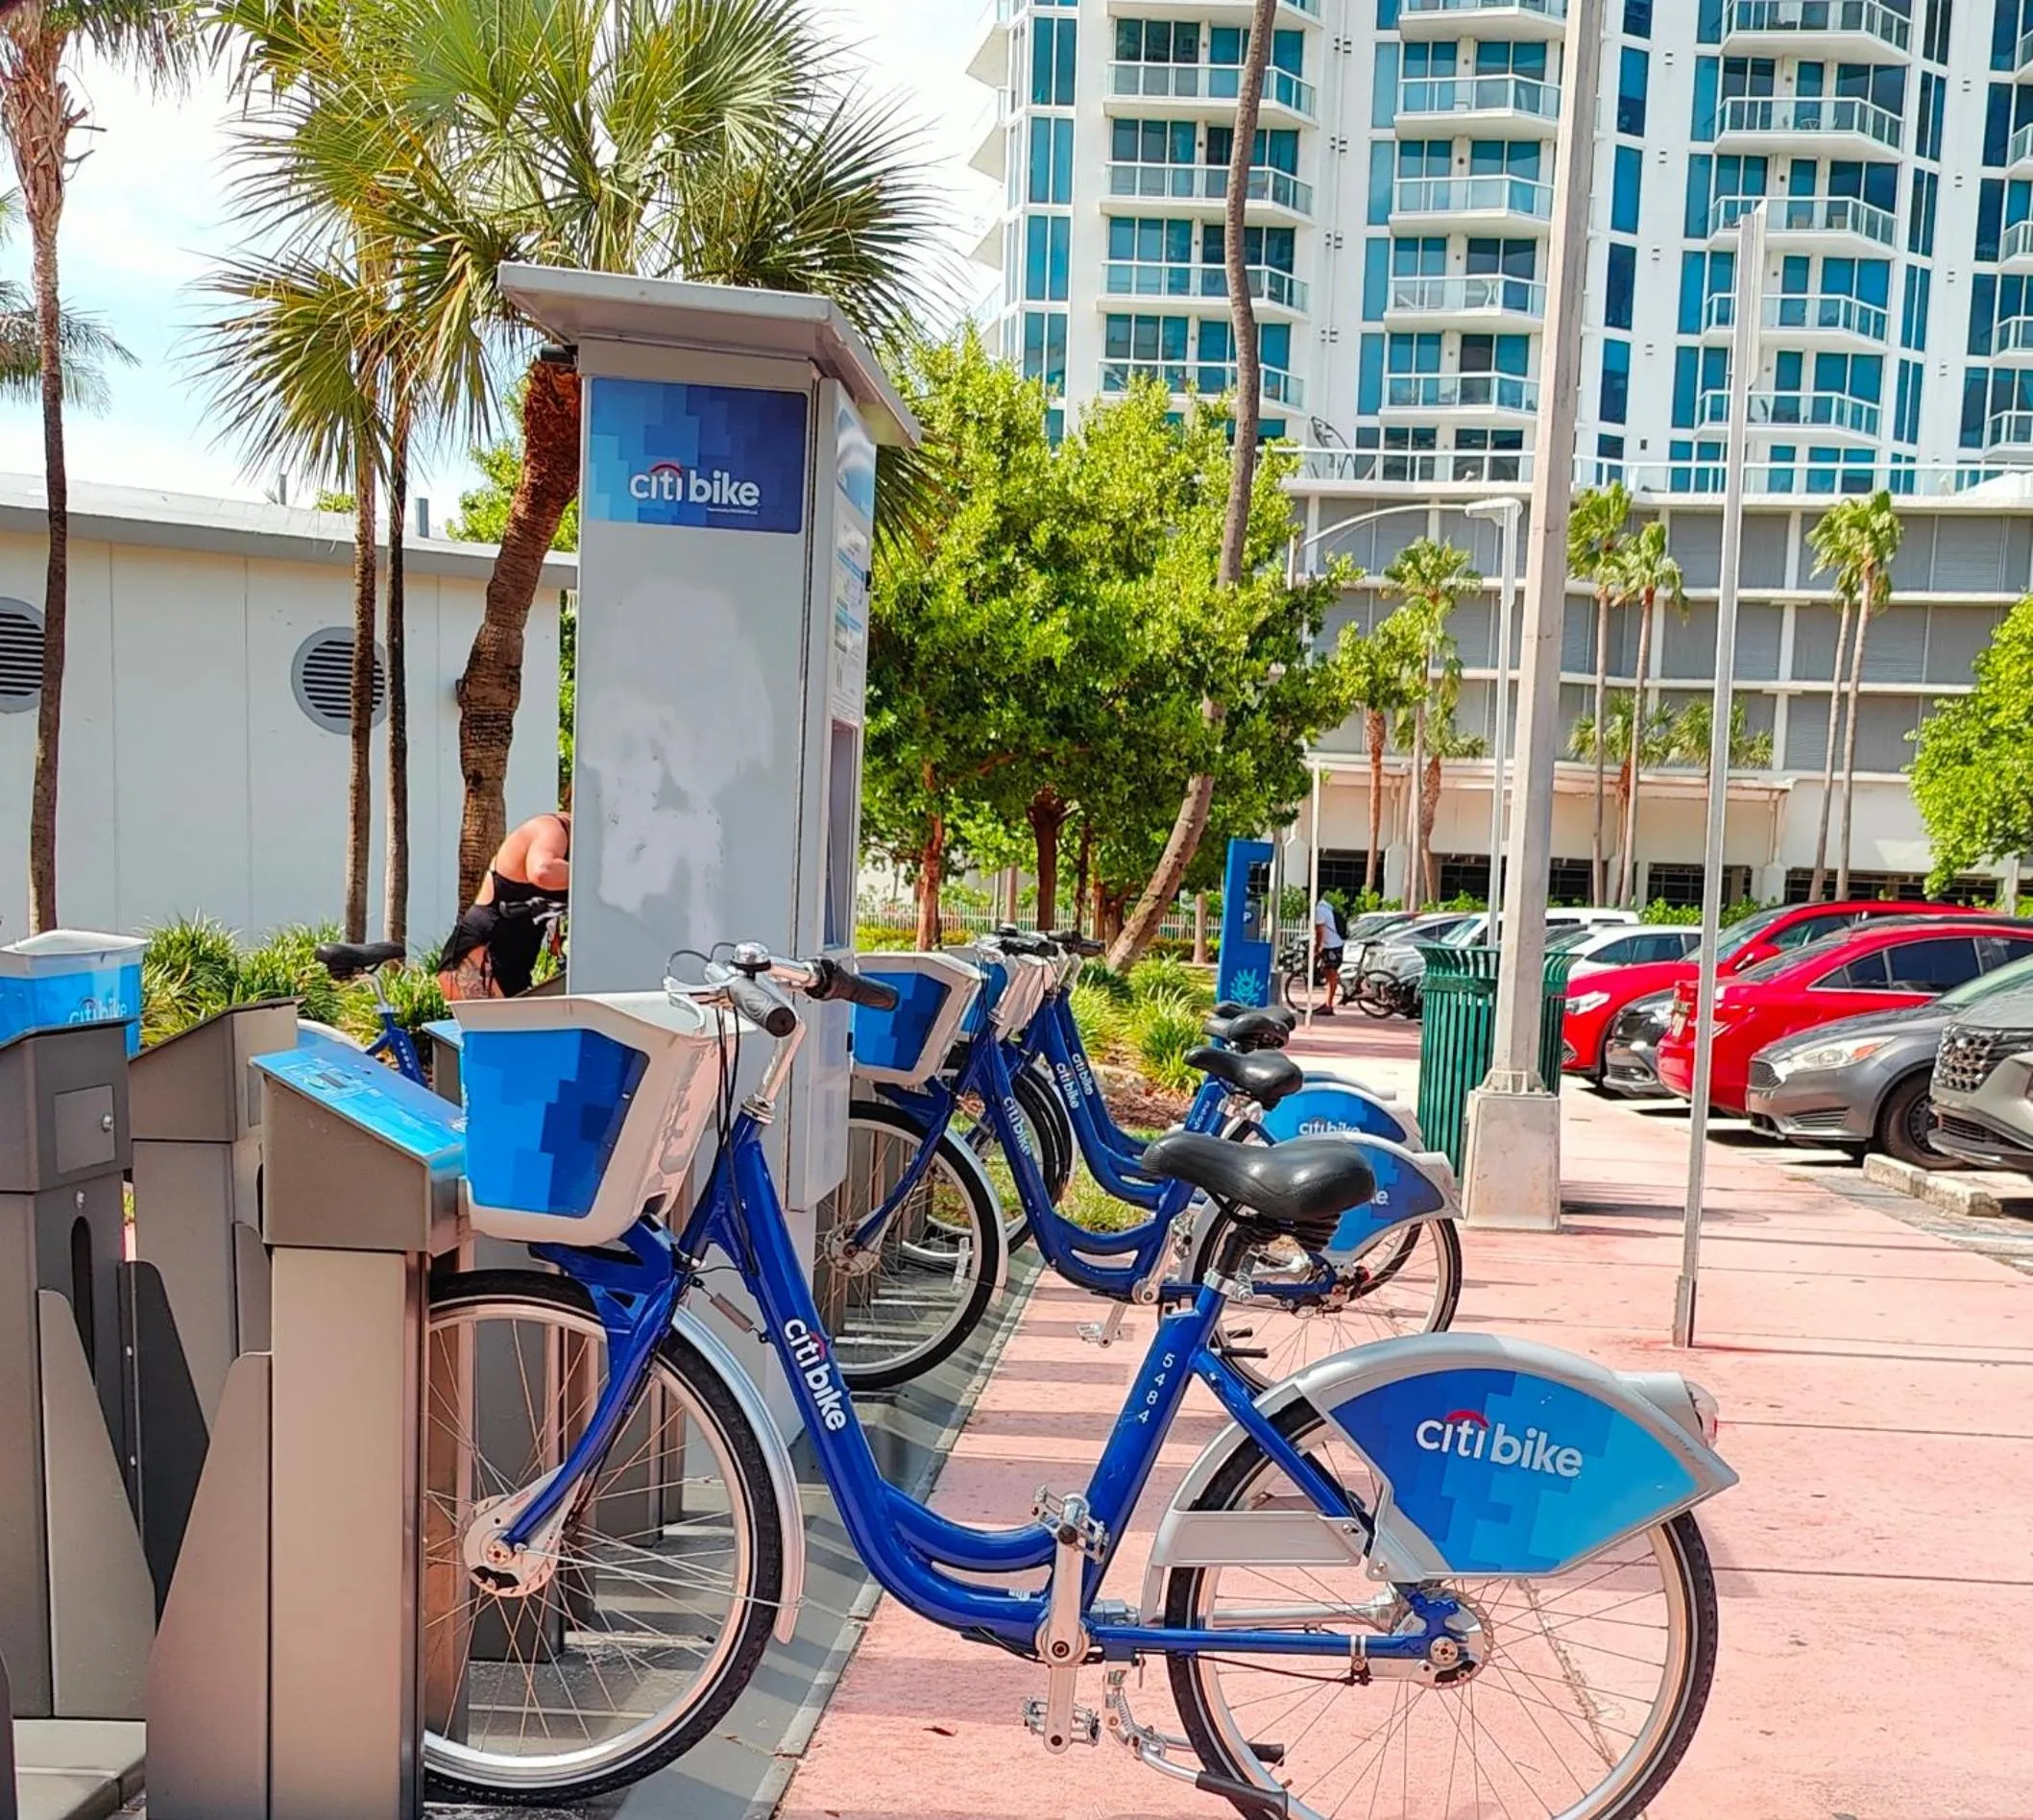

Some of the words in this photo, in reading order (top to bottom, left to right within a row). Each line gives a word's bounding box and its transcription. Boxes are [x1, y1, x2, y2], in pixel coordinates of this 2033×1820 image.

[630, 471, 683, 501] citi
[689, 469, 761, 507] bike
[784, 1319, 820, 1368] citi
[805, 1363, 847, 1431] bike
[1138, 1352, 1175, 1424] 5484
[1416, 1420, 1488, 1460] citi
[1489, 1422, 1584, 1478] bike
